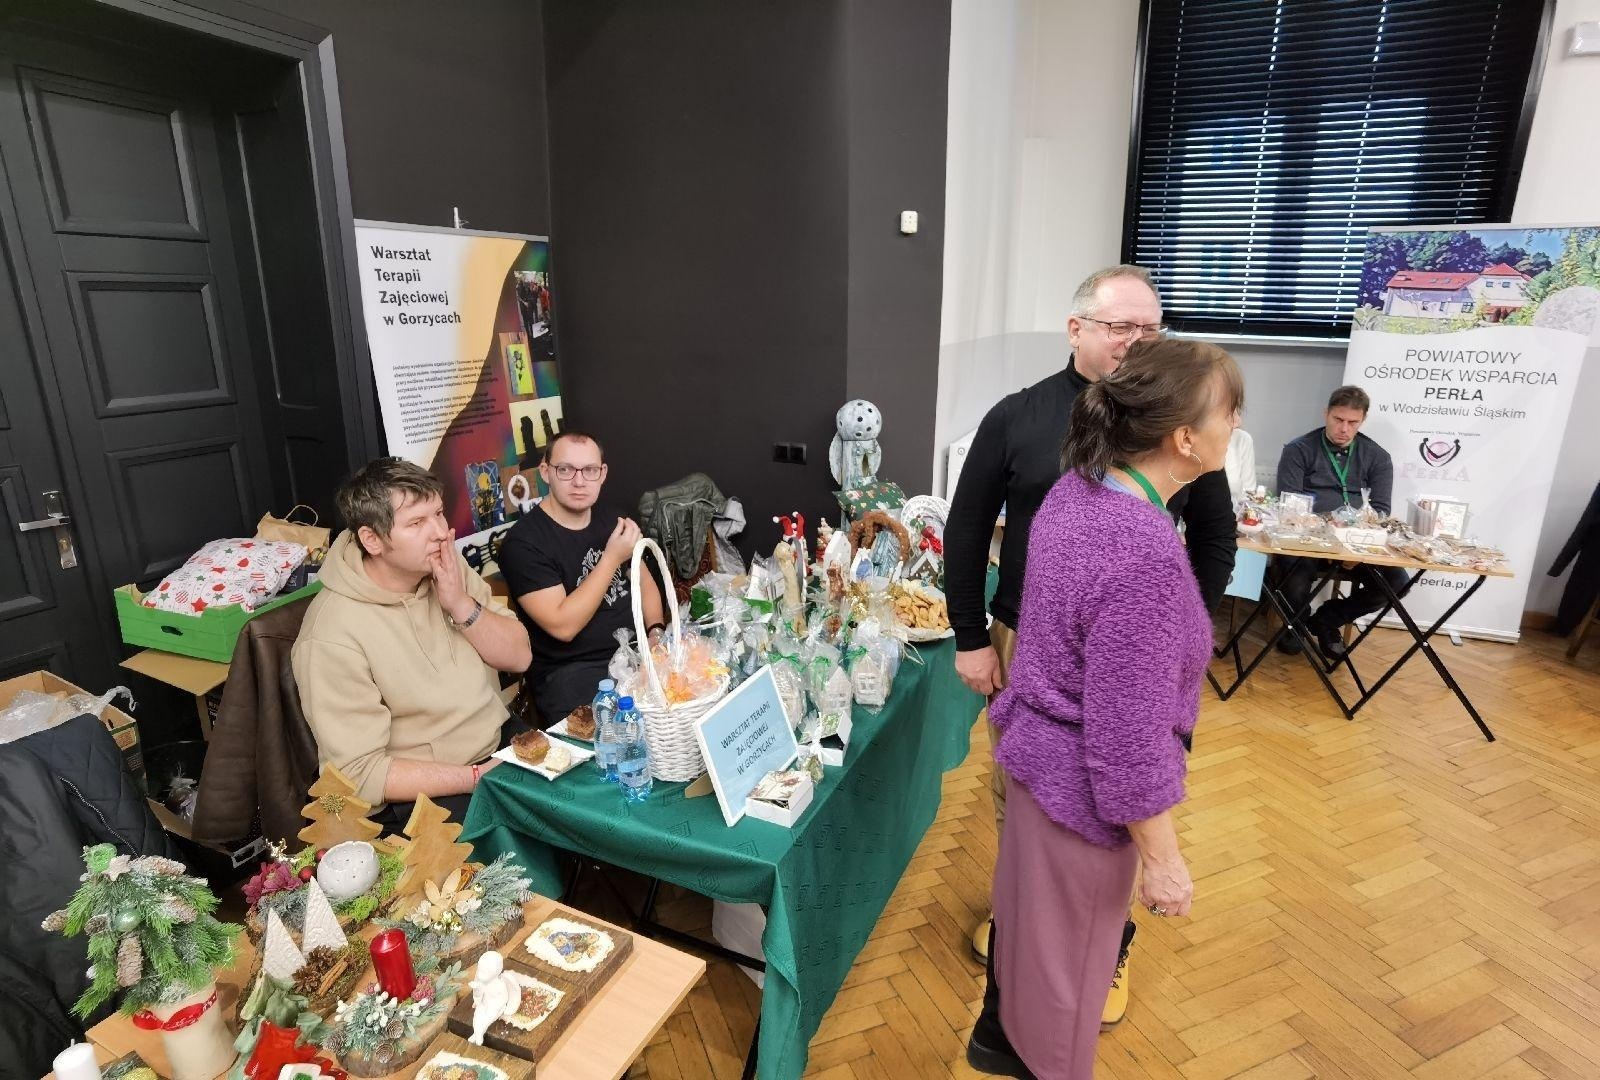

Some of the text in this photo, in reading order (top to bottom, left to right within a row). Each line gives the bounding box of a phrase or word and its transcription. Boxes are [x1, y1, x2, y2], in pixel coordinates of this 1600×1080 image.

[370, 245, 432, 262] Warsztat
[374, 268, 421, 284] Terapii
[378, 290, 449, 306] Zajęciowej
[383, 311, 461, 327] w Gorzycach
[1405, 349, 1522, 365] POWIATOWY
[1364, 363, 1558, 386] OŚRODEK WSPARCIA
[1424, 386, 1484, 402] PERŁA
[1379, 402, 1526, 420] w Wodzisławiu Śląskim
[1413, 578, 1469, 591] perla.pl
[720, 700, 771, 749] WARSZTAT TERAPII
[736, 734, 776, 776] W GORZYCACH
